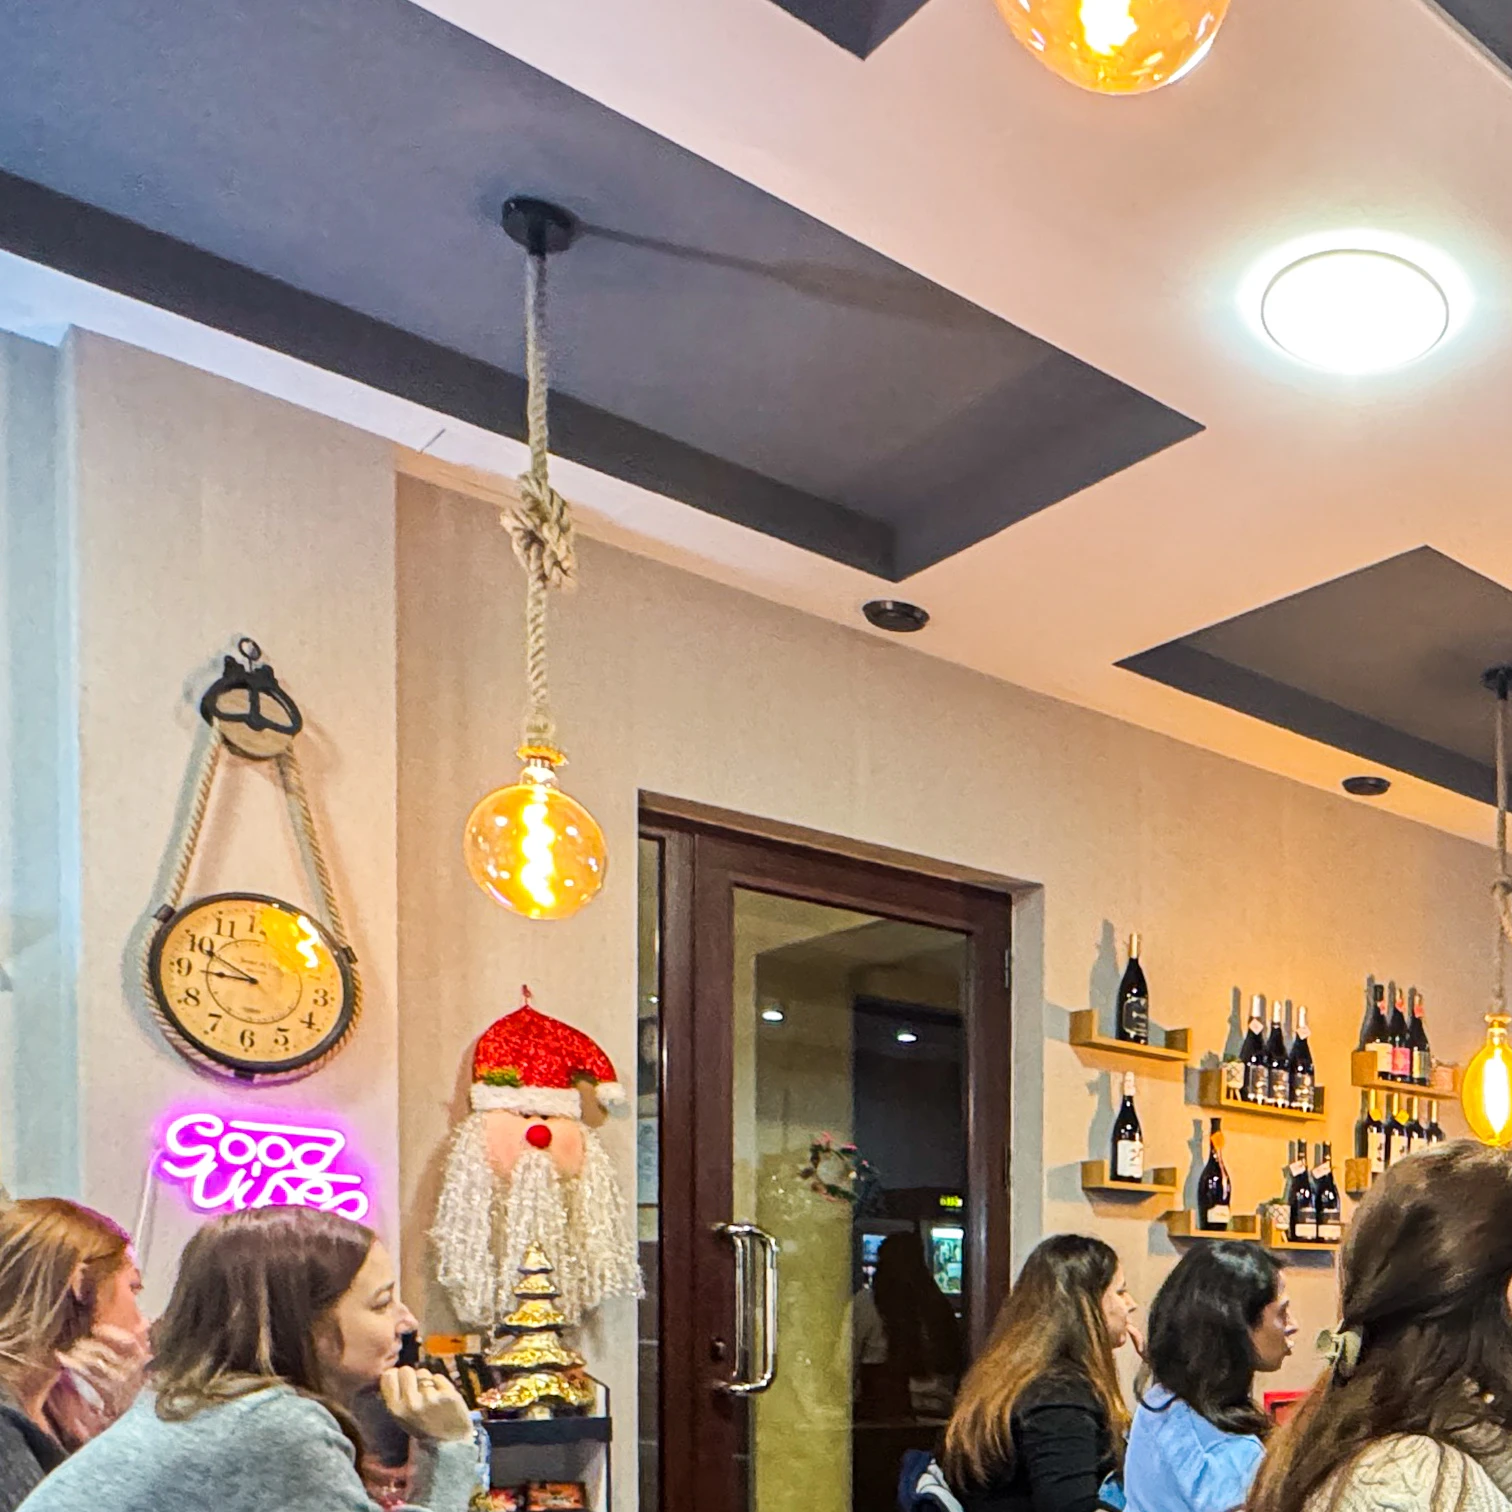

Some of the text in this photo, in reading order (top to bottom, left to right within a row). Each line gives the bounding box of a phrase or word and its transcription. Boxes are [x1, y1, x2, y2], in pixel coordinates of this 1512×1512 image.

[215, 915, 236, 939] 11
[188, 933, 215, 956] 10
[176, 957, 192, 976] 9
[183, 988, 201, 1007] 8
[313, 988, 329, 1007] 3
[208, 1012, 223, 1032] 7
[300, 1011, 316, 1030] 4
[240, 1028, 255, 1048] 6
[274, 1027, 290, 1046] 5
